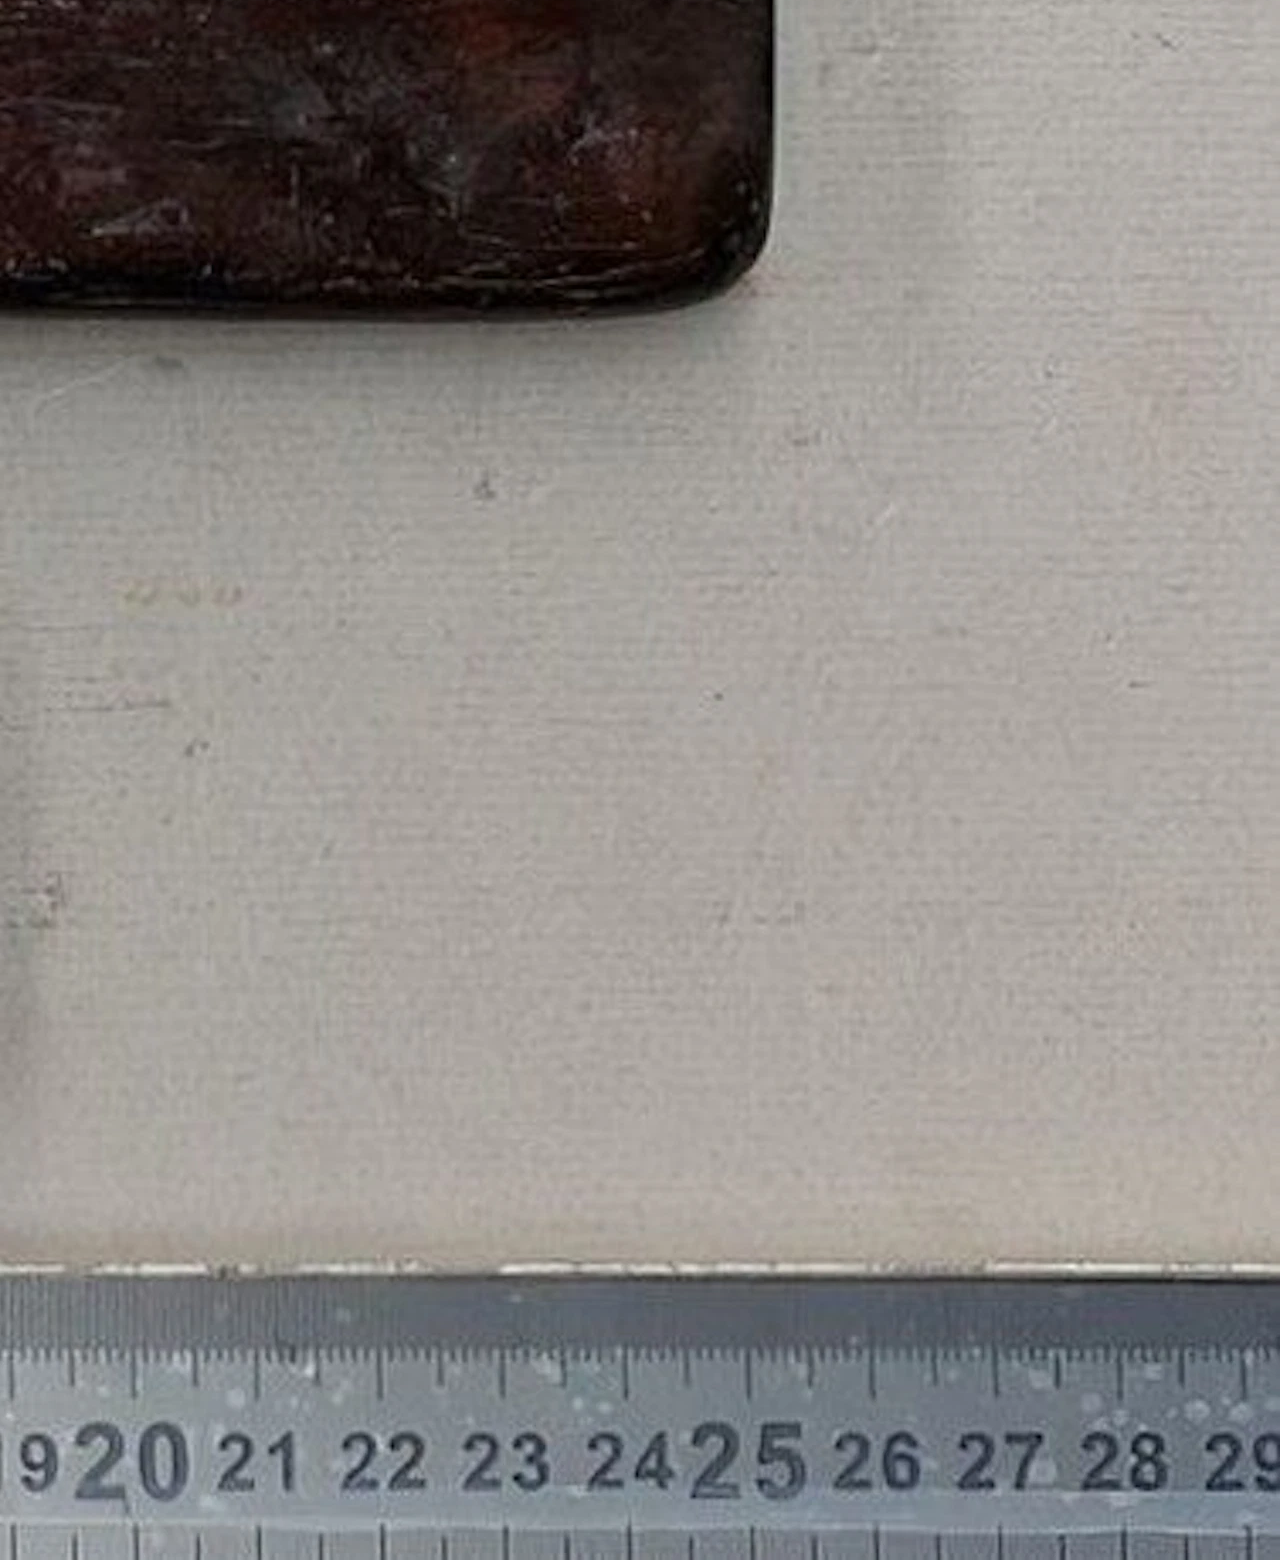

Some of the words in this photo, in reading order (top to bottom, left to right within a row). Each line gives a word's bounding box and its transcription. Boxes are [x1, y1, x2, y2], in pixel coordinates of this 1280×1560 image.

[74, 1421, 190, 1502] 20
[217, 1432, 296, 1492] 21
[340, 1432, 428, 1491] 22
[462, 1432, 550, 1491] 23
[587, 1432, 675, 1491] 24
[690, 1422, 806, 1501] 25
[833, 1432, 920, 1491] 26
[957, 1432, 1044, 1491] 27
[1081, 1432, 1167, 1492] 28
[1205, 1433, 1280, 1493] 29
